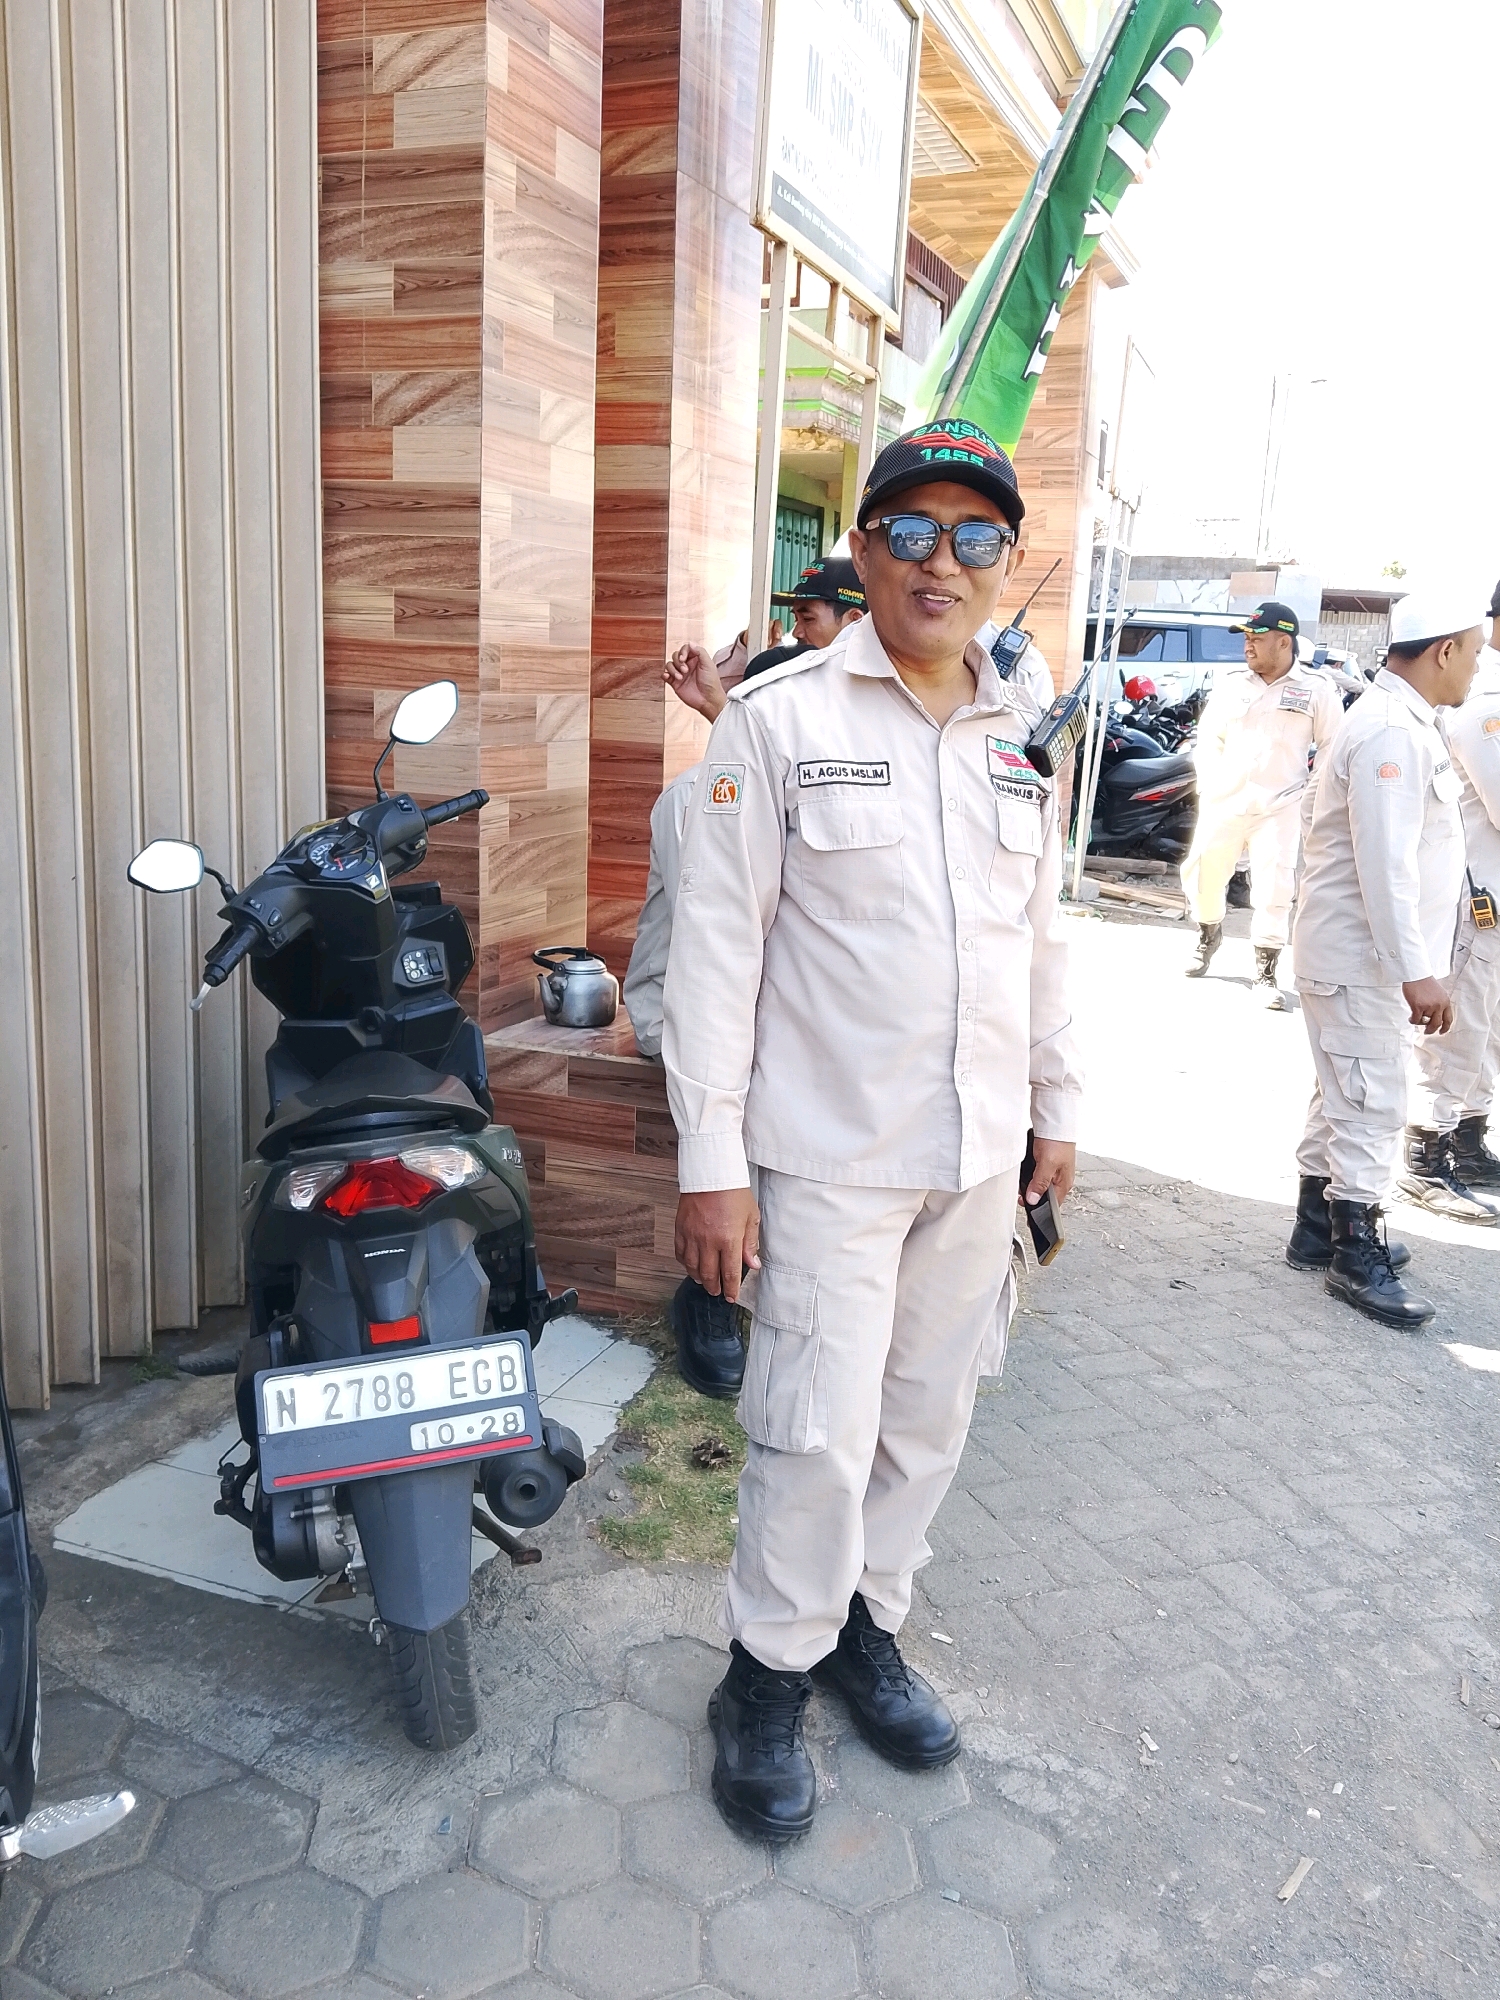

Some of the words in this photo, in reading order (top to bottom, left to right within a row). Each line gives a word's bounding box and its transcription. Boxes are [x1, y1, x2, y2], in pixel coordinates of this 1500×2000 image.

[920, 448, 983, 467] 1455
[803, 768, 814, 779] H.
[818, 766, 849, 778] AGUS
[364, 1248, 406, 1258] HONDA
[275, 1387, 297, 1429] N
[322, 1372, 416, 1421] 2788
[448, 1355, 517, 1399] EGB
